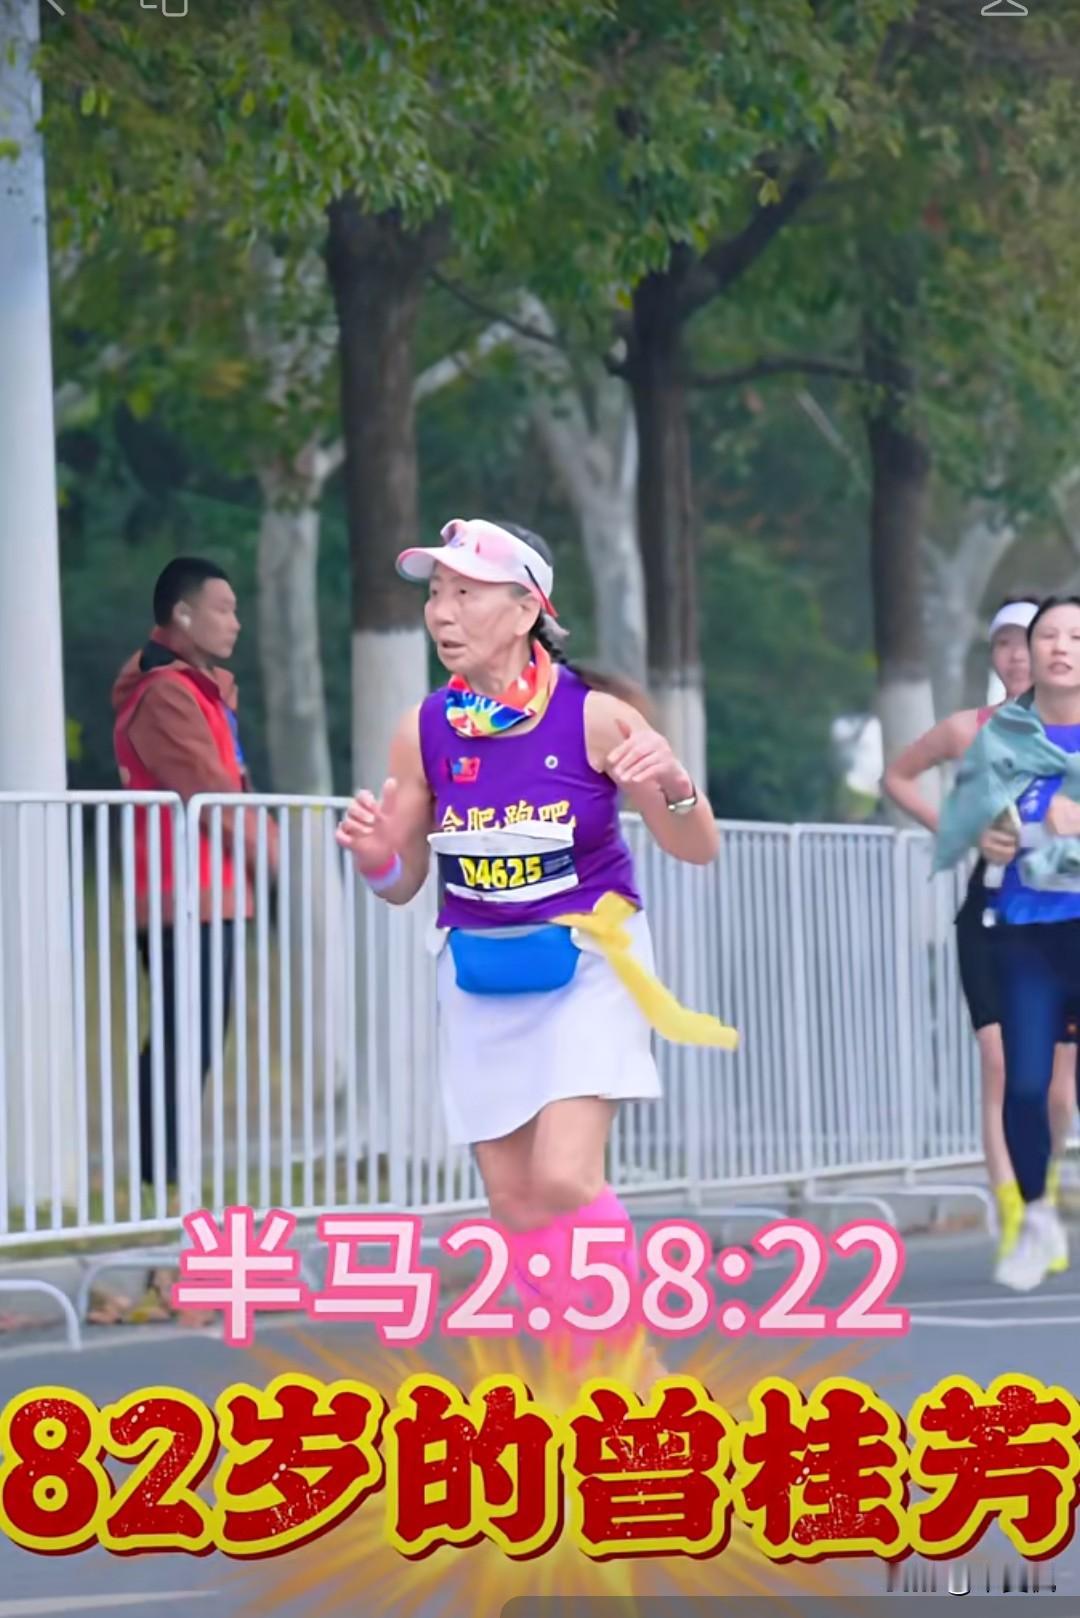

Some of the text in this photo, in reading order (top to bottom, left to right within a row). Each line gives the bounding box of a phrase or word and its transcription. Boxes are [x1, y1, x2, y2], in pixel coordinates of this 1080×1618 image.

[441, 800, 576, 834] 合肥跑吧
[459, 856, 543, 889] D4625
